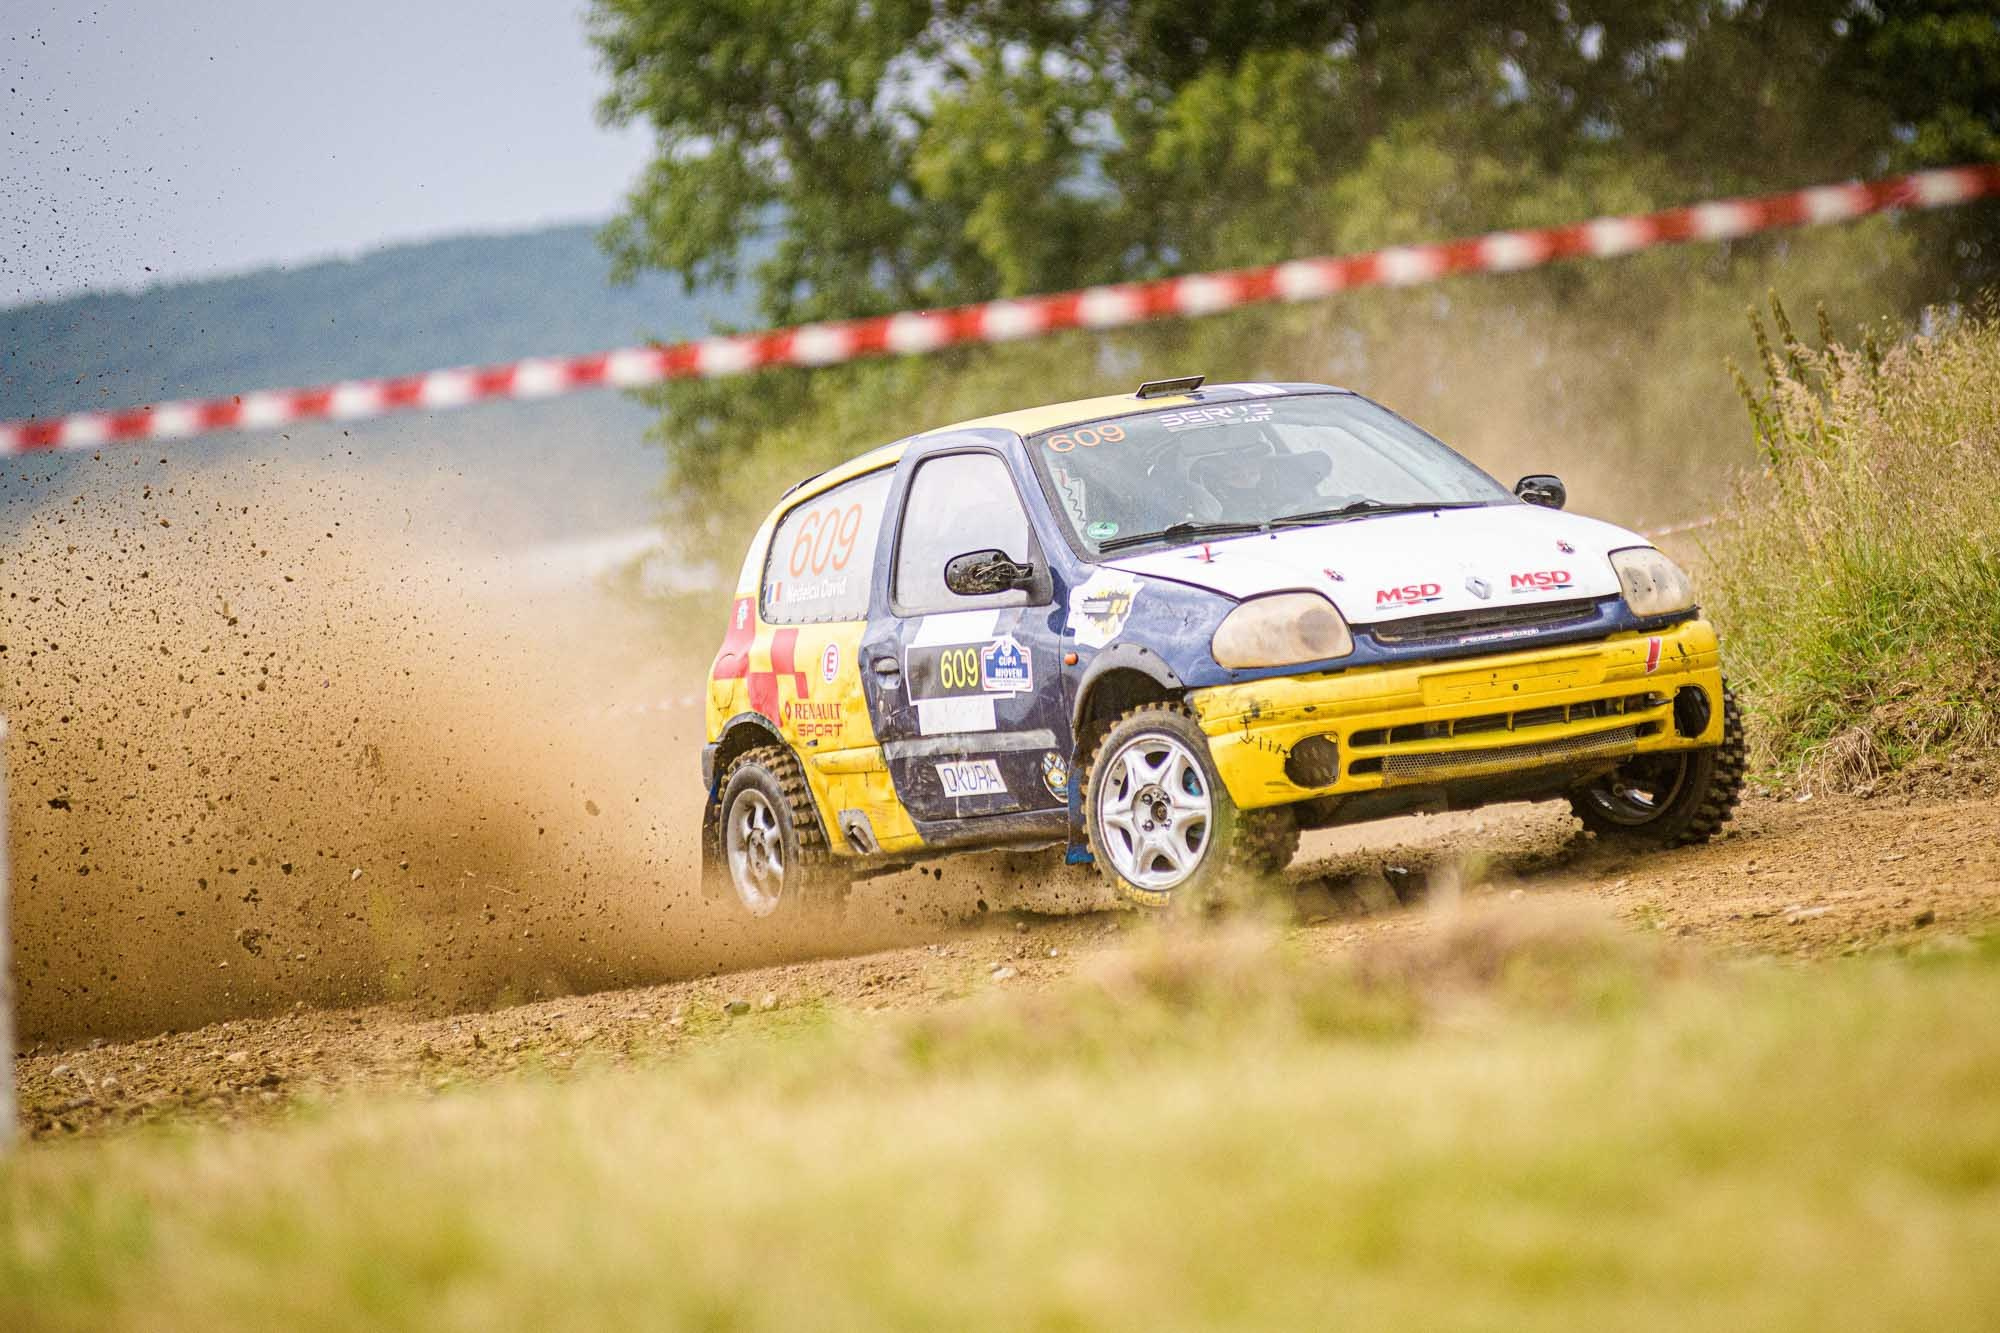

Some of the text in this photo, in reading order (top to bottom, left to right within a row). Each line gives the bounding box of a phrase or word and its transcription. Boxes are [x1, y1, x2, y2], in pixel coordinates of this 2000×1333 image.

[1047, 424, 1126, 453] 609
[791, 504, 862, 576] 609
[821, 576, 847, 598] David
[1511, 570, 1570, 587] MSD
[1376, 584, 1441, 603] MSD
[825, 652, 835, 674] E
[941, 648, 978, 689] 609
[998, 655, 1017, 667] CUPA
[795, 702, 842, 721] RENAULT
[798, 723, 844, 738] SPORT
